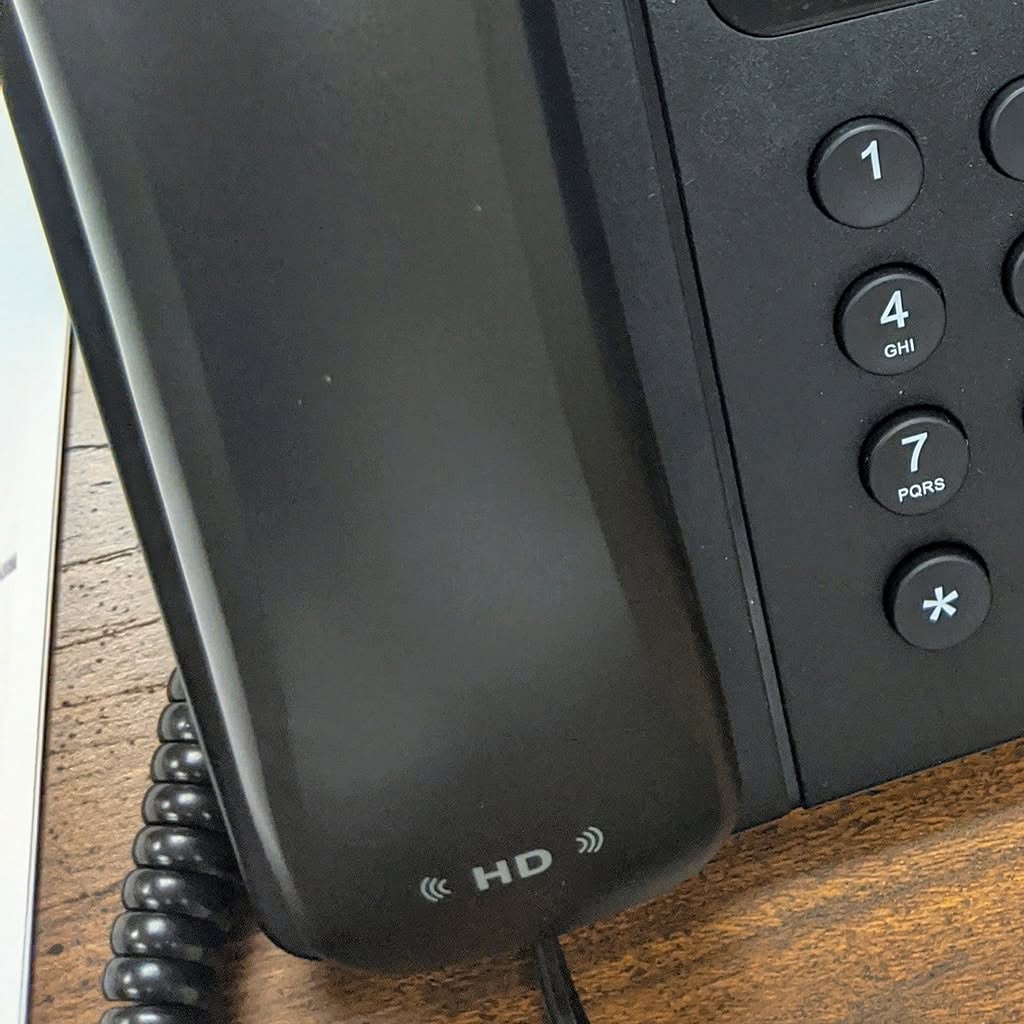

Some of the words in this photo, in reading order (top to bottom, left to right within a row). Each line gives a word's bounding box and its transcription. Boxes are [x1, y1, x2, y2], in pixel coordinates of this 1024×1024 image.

[860, 139, 882, 180] 1
[879, 290, 909, 329] 4
[883, 338, 915, 358] GHI
[899, 432, 929, 473] 7
[897, 477, 946, 503] PQRS
[472, 849, 552, 891] HD
